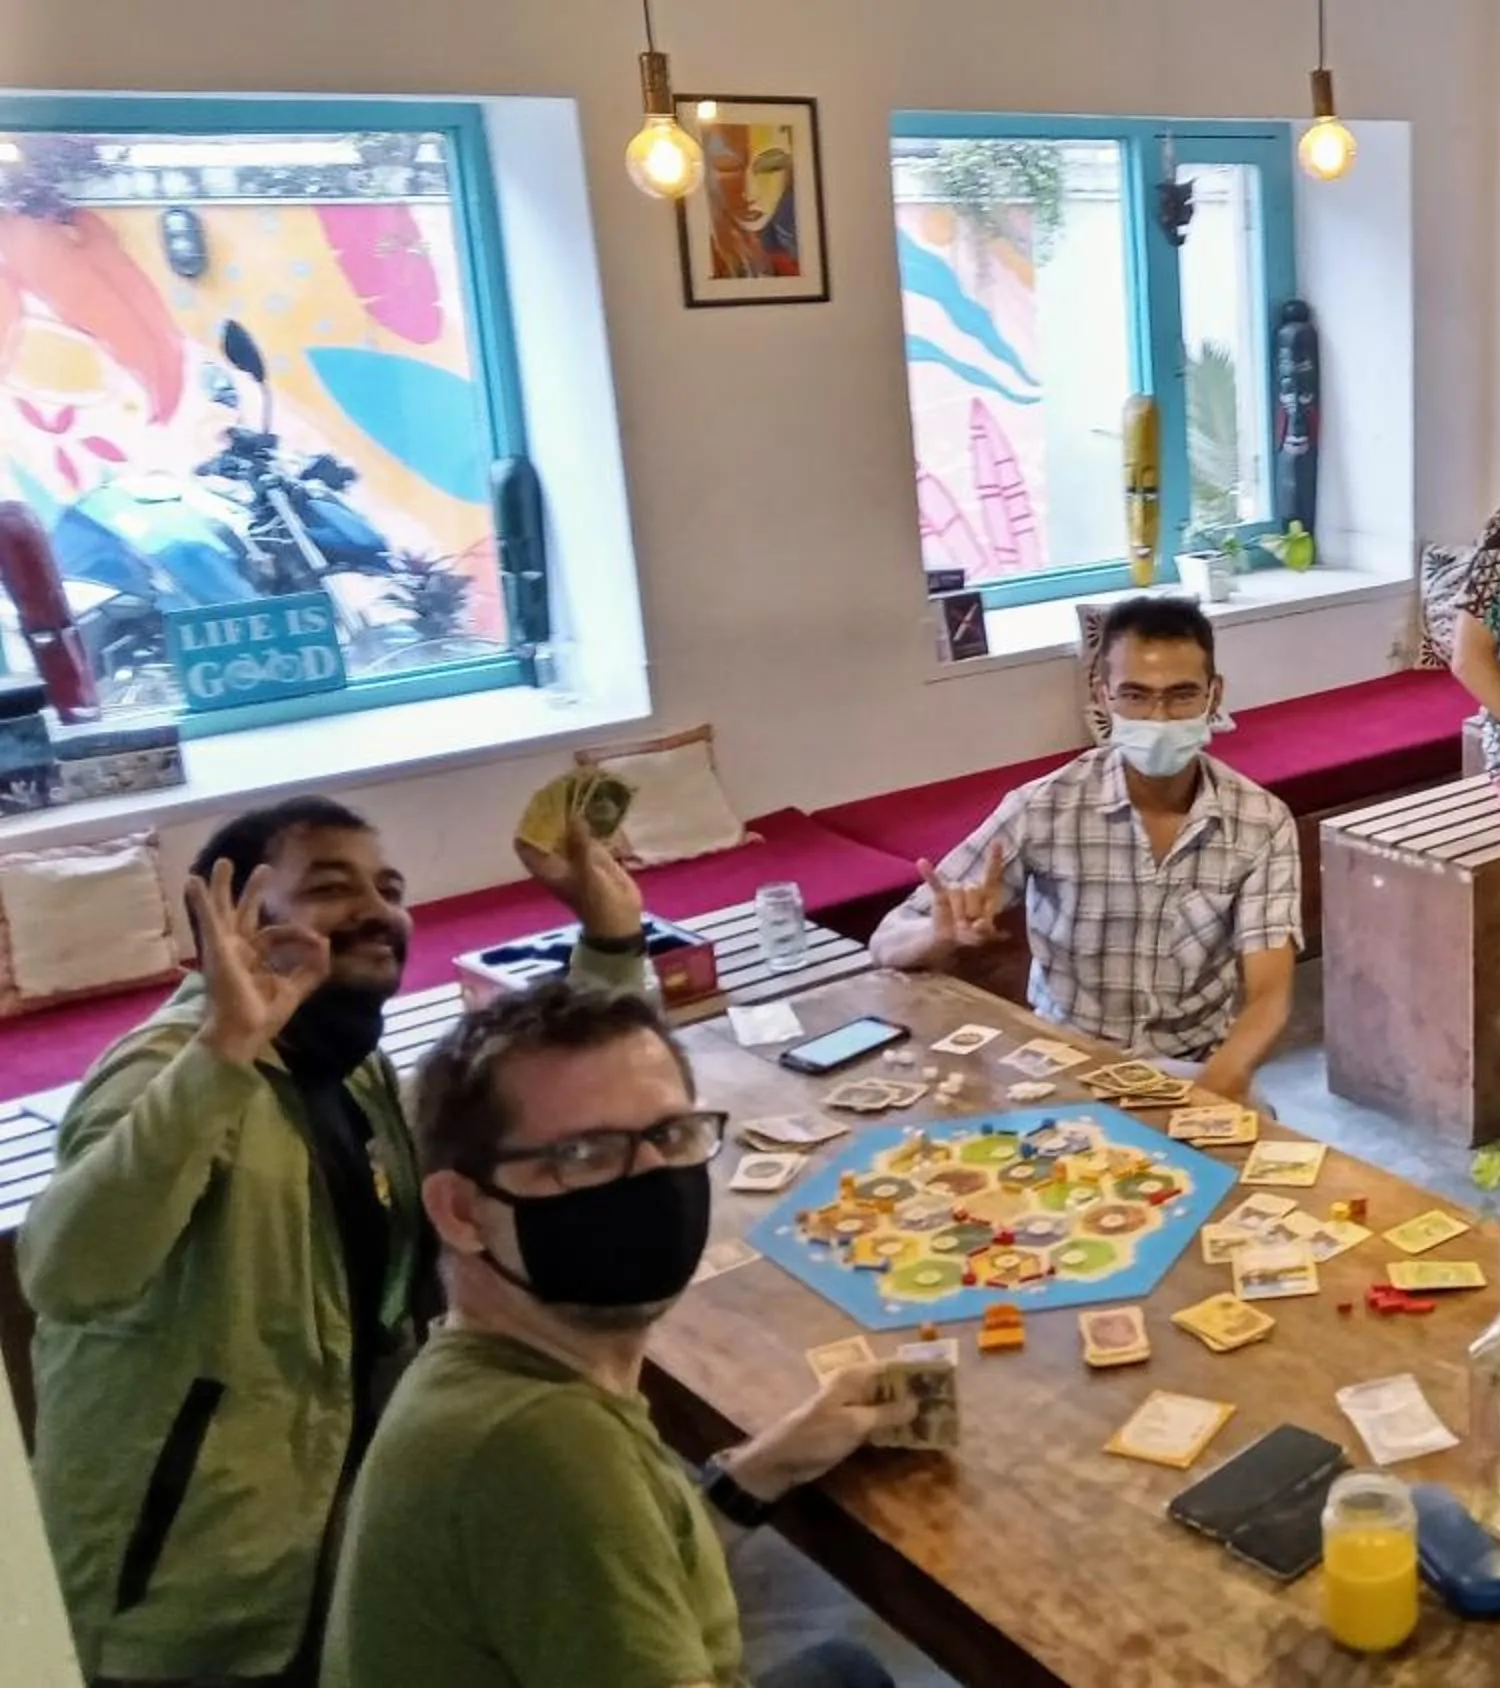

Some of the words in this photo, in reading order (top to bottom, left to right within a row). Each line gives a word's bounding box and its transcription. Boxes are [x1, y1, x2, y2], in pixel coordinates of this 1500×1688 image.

[177, 613, 275, 650] LIFE
[285, 605, 328, 636] IS
[187, 645, 338, 699] GOOD
